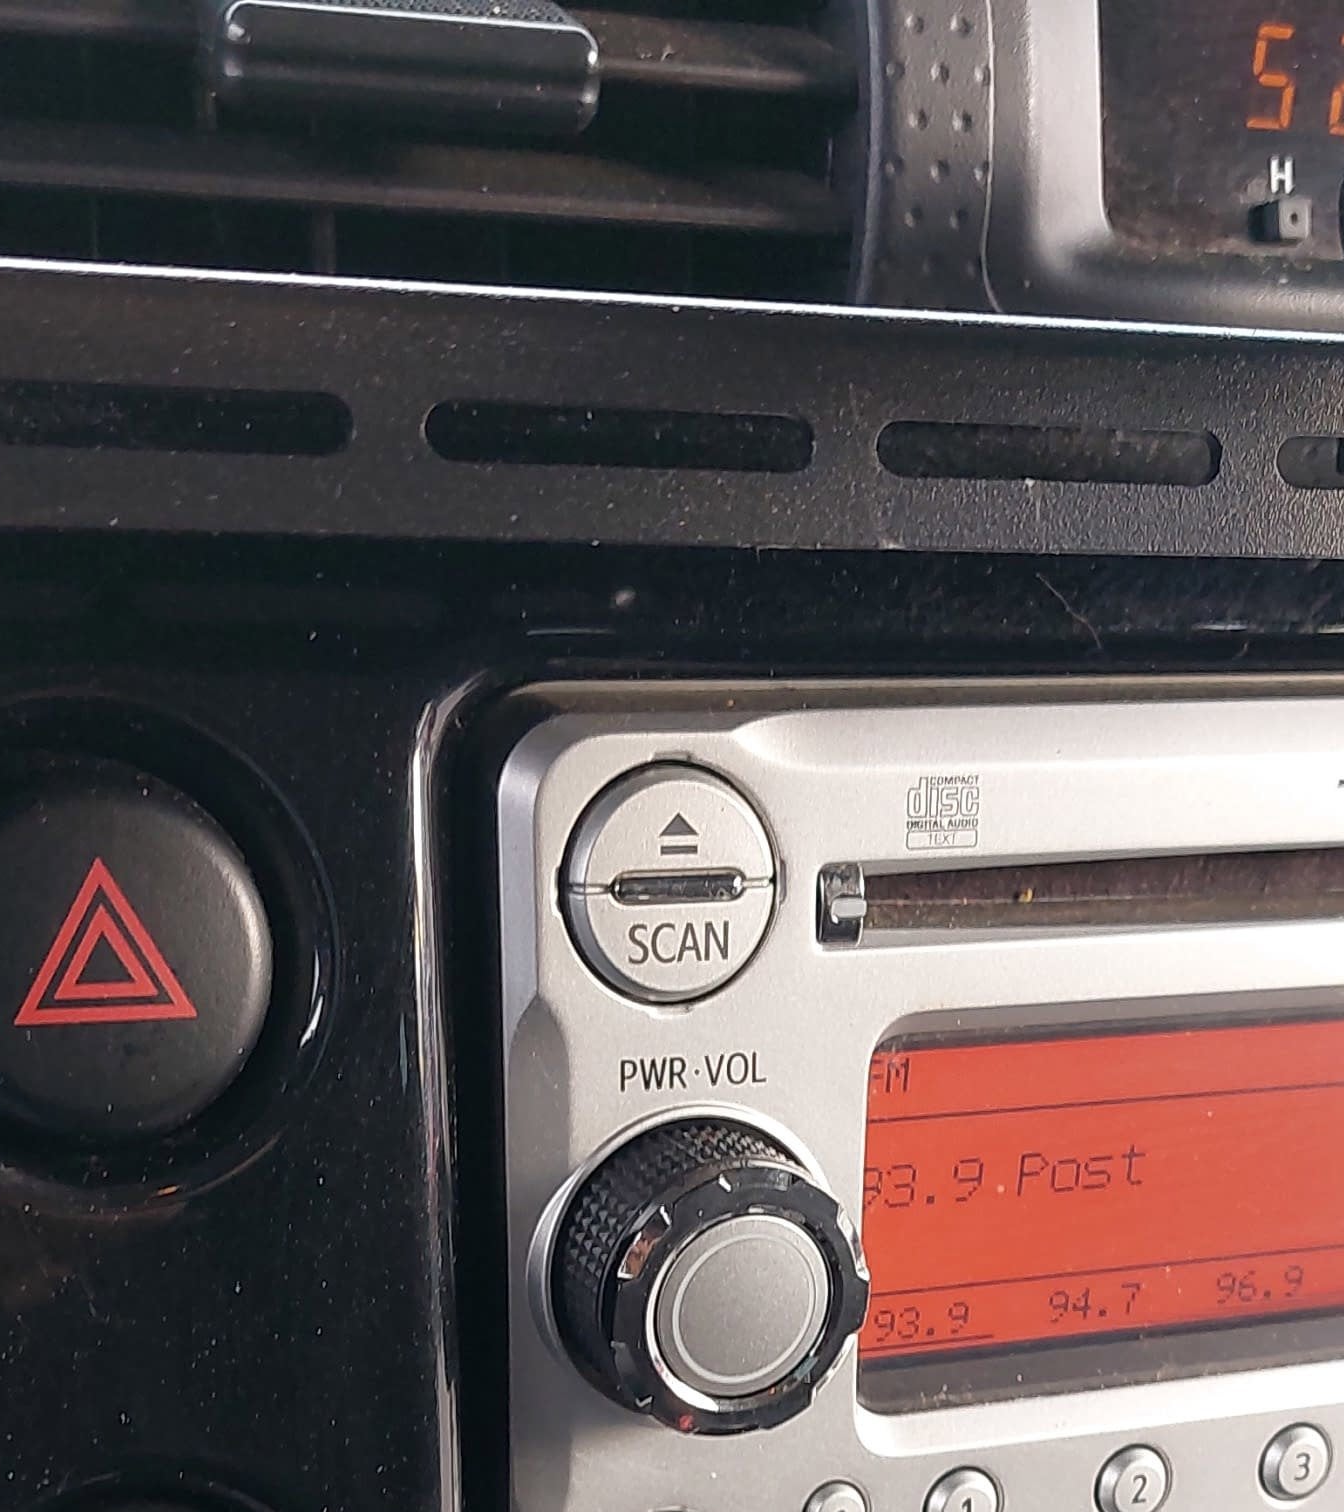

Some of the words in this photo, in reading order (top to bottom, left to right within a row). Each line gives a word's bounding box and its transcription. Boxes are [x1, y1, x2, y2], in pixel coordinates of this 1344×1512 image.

[1269, 155, 1295, 195] H
[906, 776, 980, 819] disc
[929, 774, 980, 786] COMPACT
[906, 819, 945, 832] DIGITAL
[947, 818, 979, 830] AUDIO
[627, 921, 730, 965] SCAN
[1016, 1143, 1146, 1197] Post
[873, 1301, 970, 1342] 93.9
[1048, 1282, 1140, 1323] 94.7
[1215, 1264, 1304, 1304] 96.9
[1293, 1452, 1310, 1480] 3
[1131, 1476, 1148, 1506] 2
